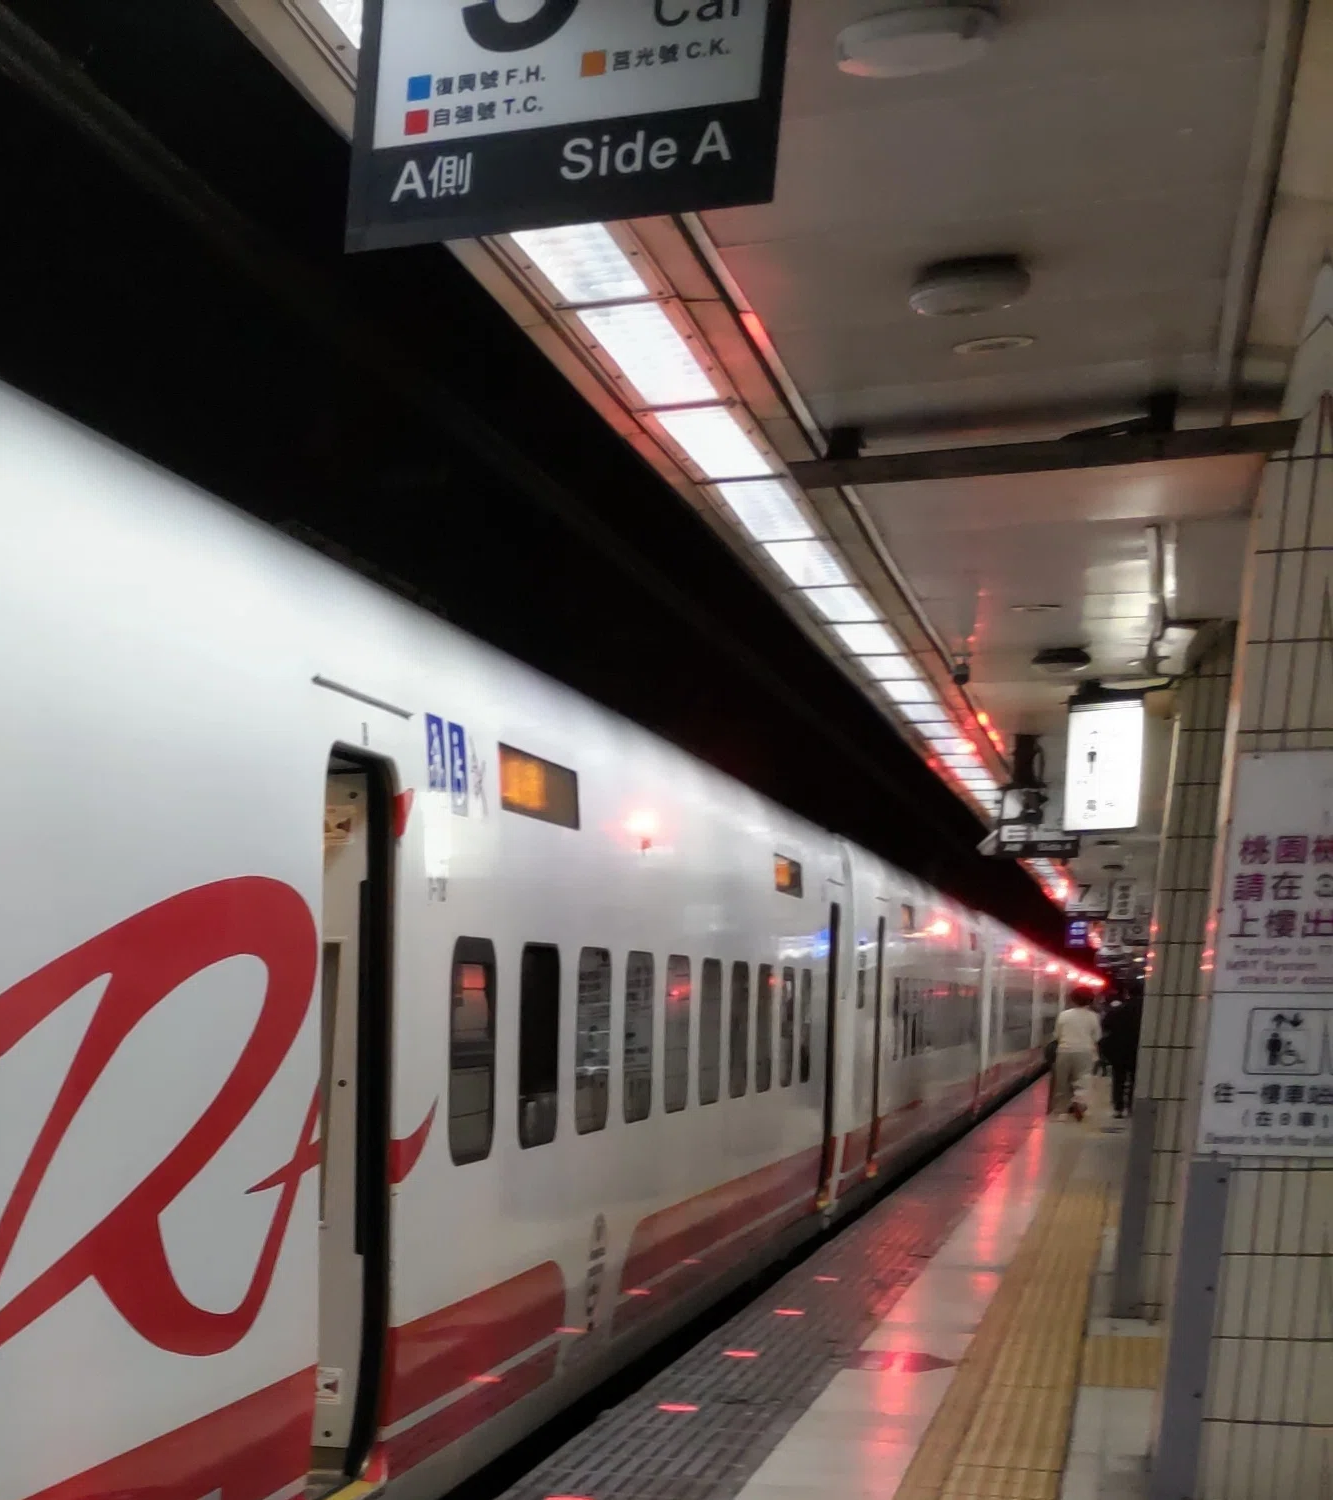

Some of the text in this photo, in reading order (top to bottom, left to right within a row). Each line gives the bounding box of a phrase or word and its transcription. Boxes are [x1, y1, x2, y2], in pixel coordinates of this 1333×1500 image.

[504, 64, 546, 86] F.H.
[502, 95, 544, 117] T.C.
[560, 120, 732, 181] Side A
[1077, 884, 1092, 902] 7
